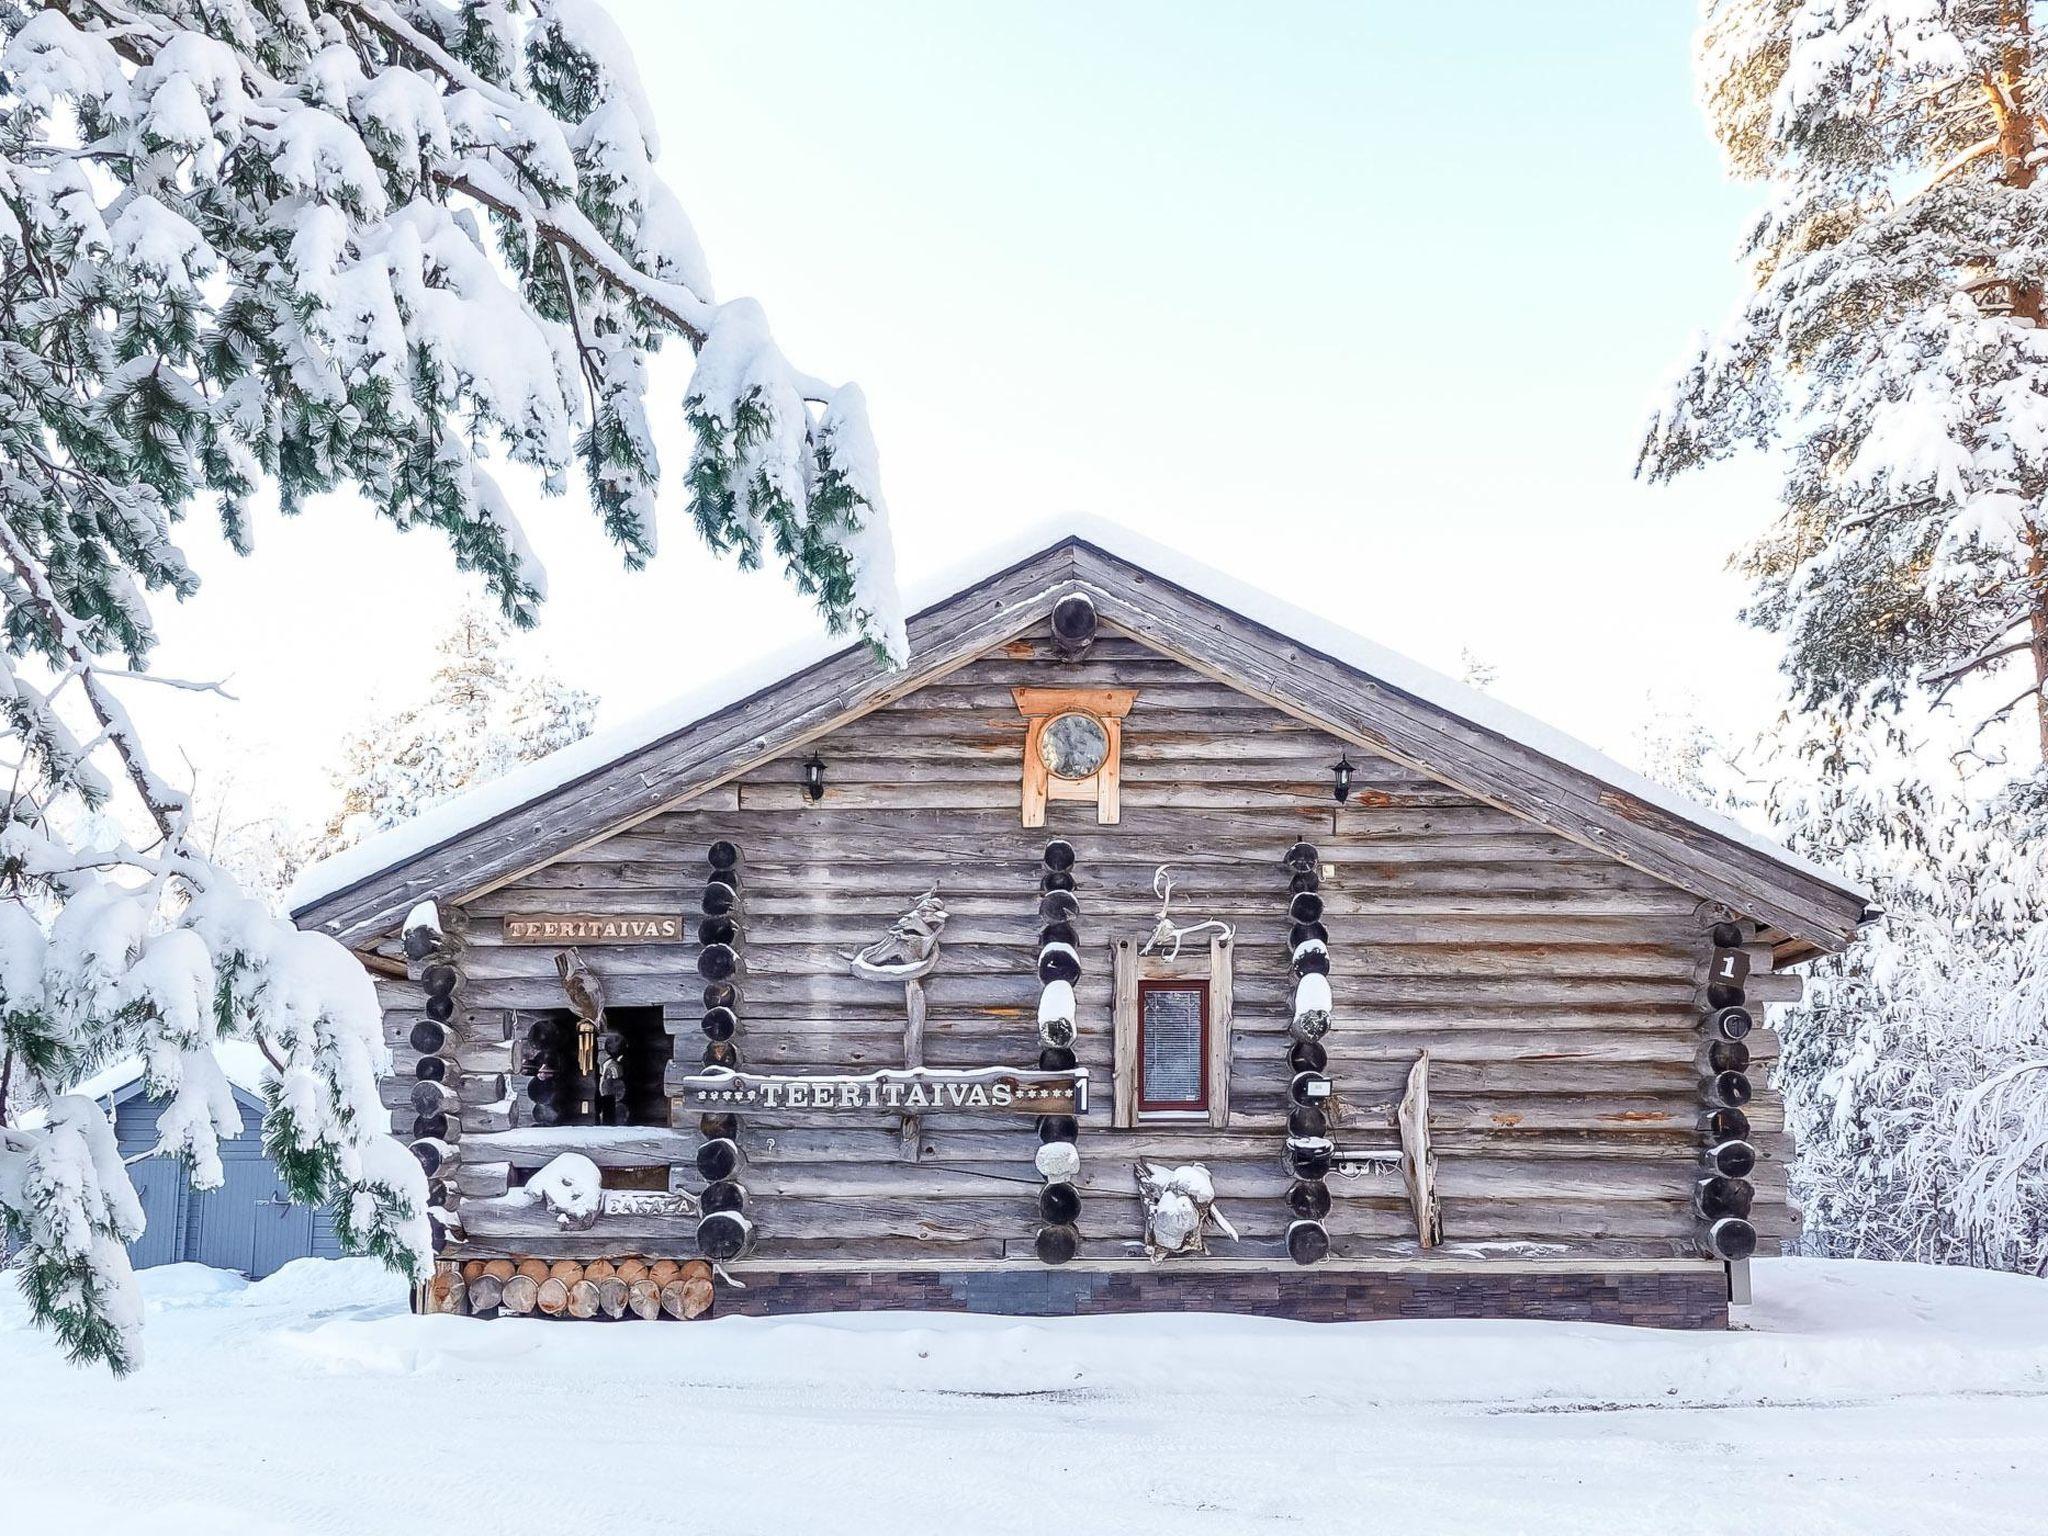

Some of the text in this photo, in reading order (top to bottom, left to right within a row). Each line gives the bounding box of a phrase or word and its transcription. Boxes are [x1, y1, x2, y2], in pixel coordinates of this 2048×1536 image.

[510, 920, 676, 937] TEERITAIVAS
[1720, 956, 1735, 978] 1
[760, 1082, 1012, 1107] TEERITAIVAS
[1075, 1078, 1088, 1111] 1
